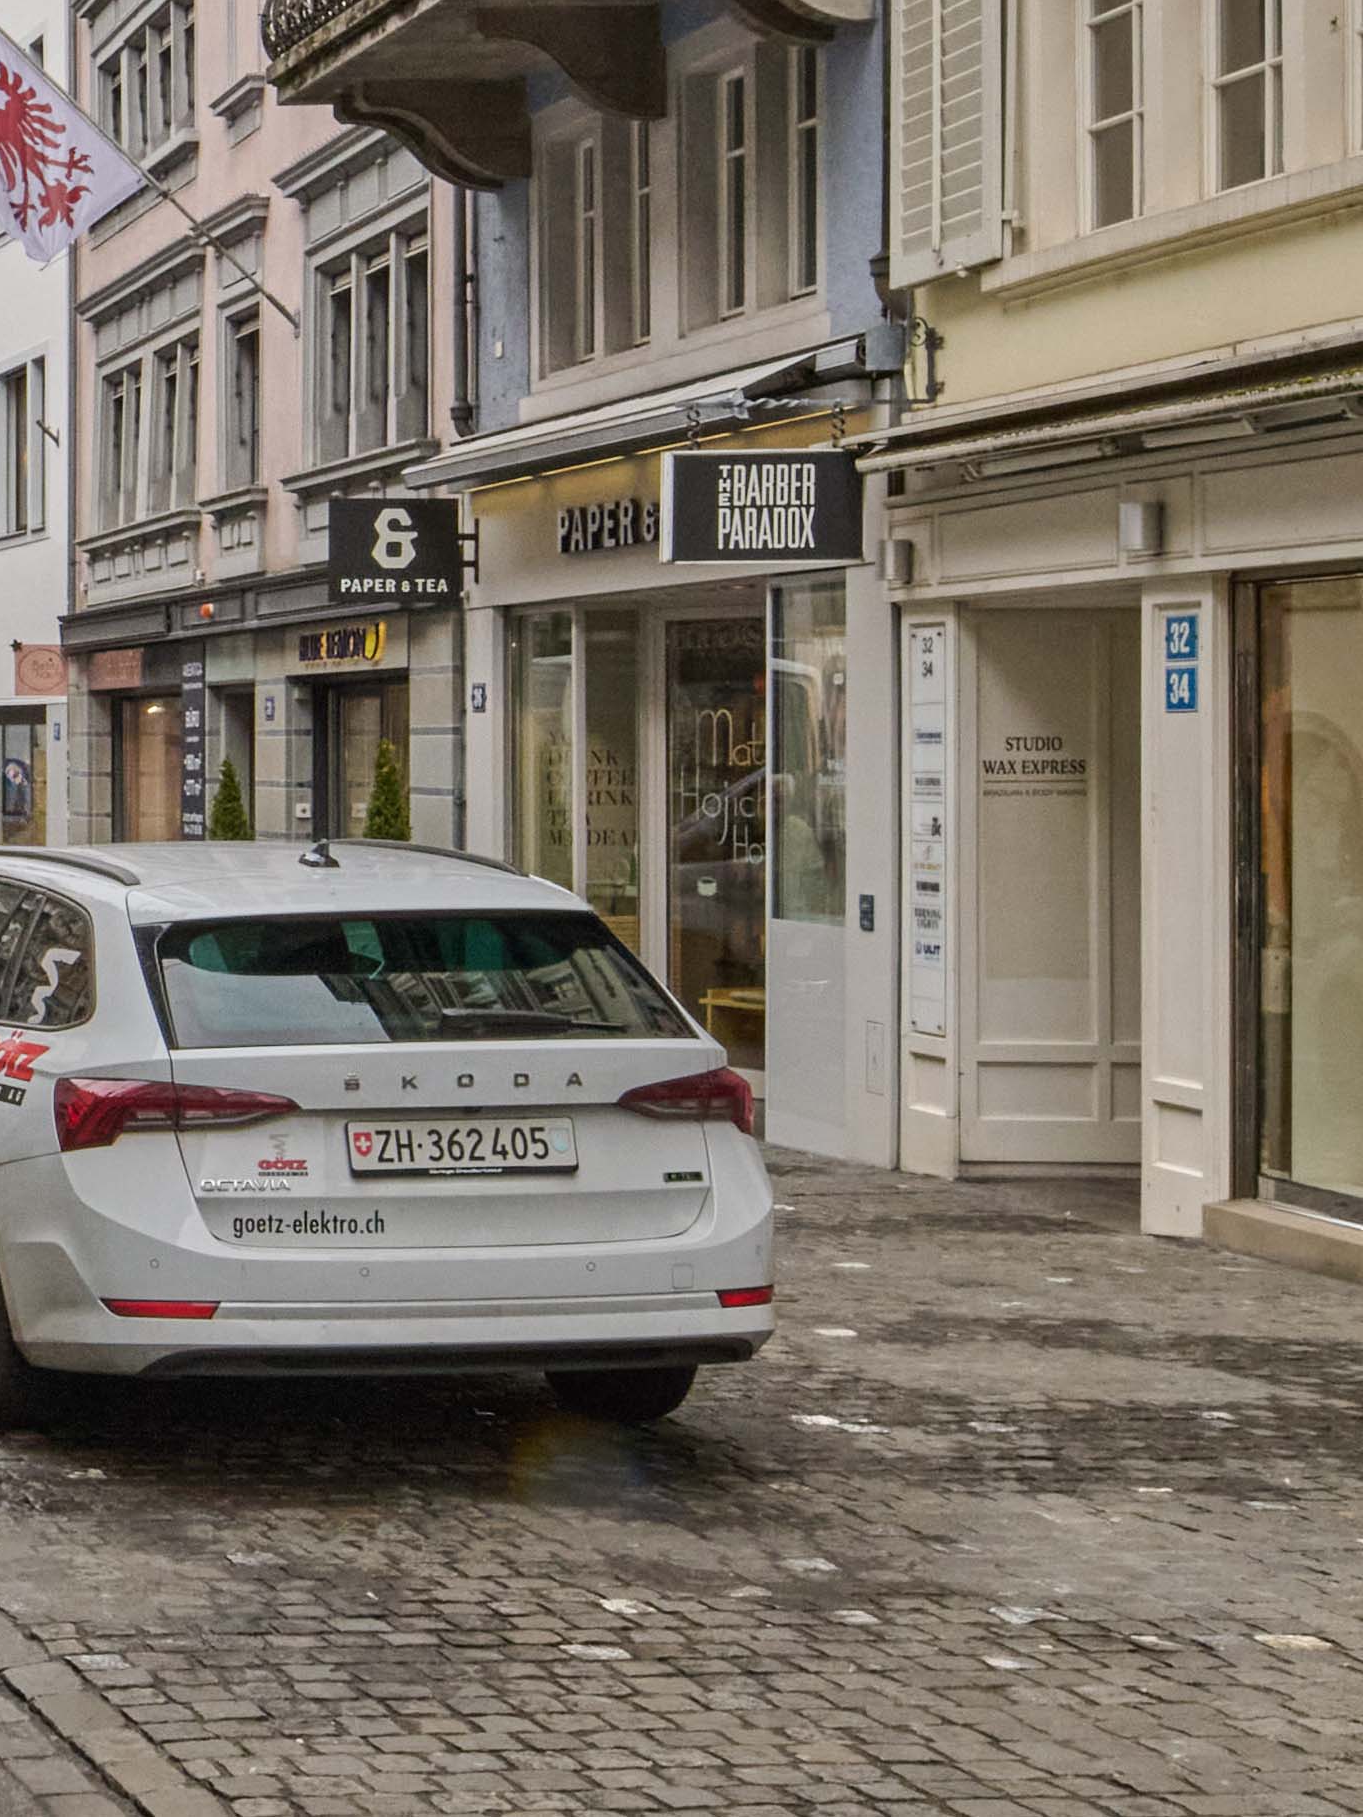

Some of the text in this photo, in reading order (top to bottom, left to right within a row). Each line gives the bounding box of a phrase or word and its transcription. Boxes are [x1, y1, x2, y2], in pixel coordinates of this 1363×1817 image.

[718, 463, 816, 506] THE BARBER
[557, 498, 634, 553] PAPER
[717, 506, 816, 550] PARADOX
[340, 578, 396, 593] PAPER
[414, 578, 448, 593] TEA
[922, 637, 933, 654] 32
[1170, 622, 1190, 654] 32
[922, 661, 933, 677] 34
[1169, 673, 1190, 704] 34
[1005, 736, 1063, 752] STUDIO
[982, 759, 1087, 775] WAX EXPRESS
[258, 1157, 308, 1171] GÖTZ
[200, 1178, 291, 1193] OCTAVIA
[233, 1210, 385, 1239] goetz-elektro.ch
